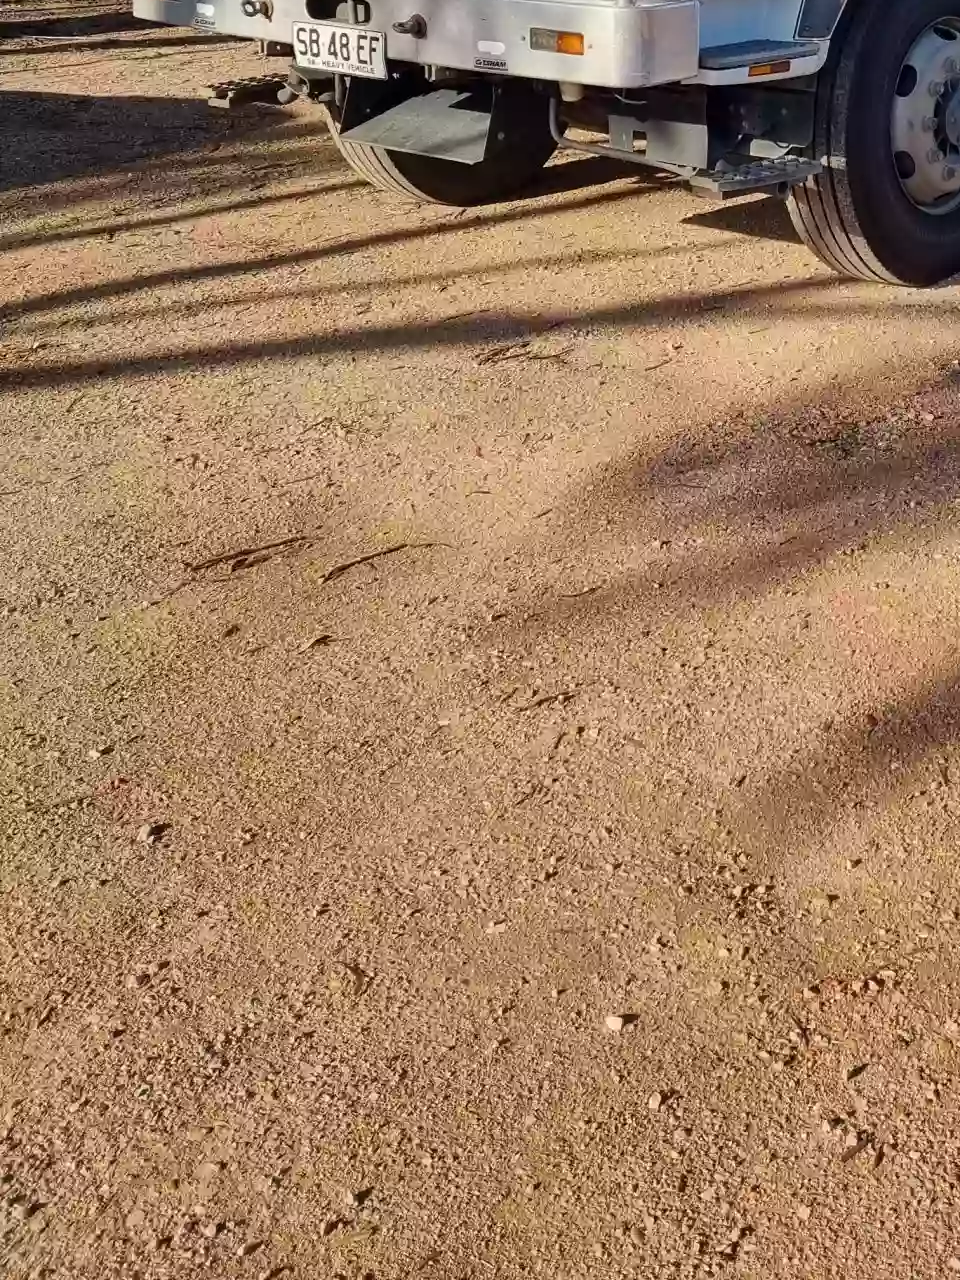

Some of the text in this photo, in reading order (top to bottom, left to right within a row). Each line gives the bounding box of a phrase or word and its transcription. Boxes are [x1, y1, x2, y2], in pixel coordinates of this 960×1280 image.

[296, 27, 379, 66] SB 48 EF
